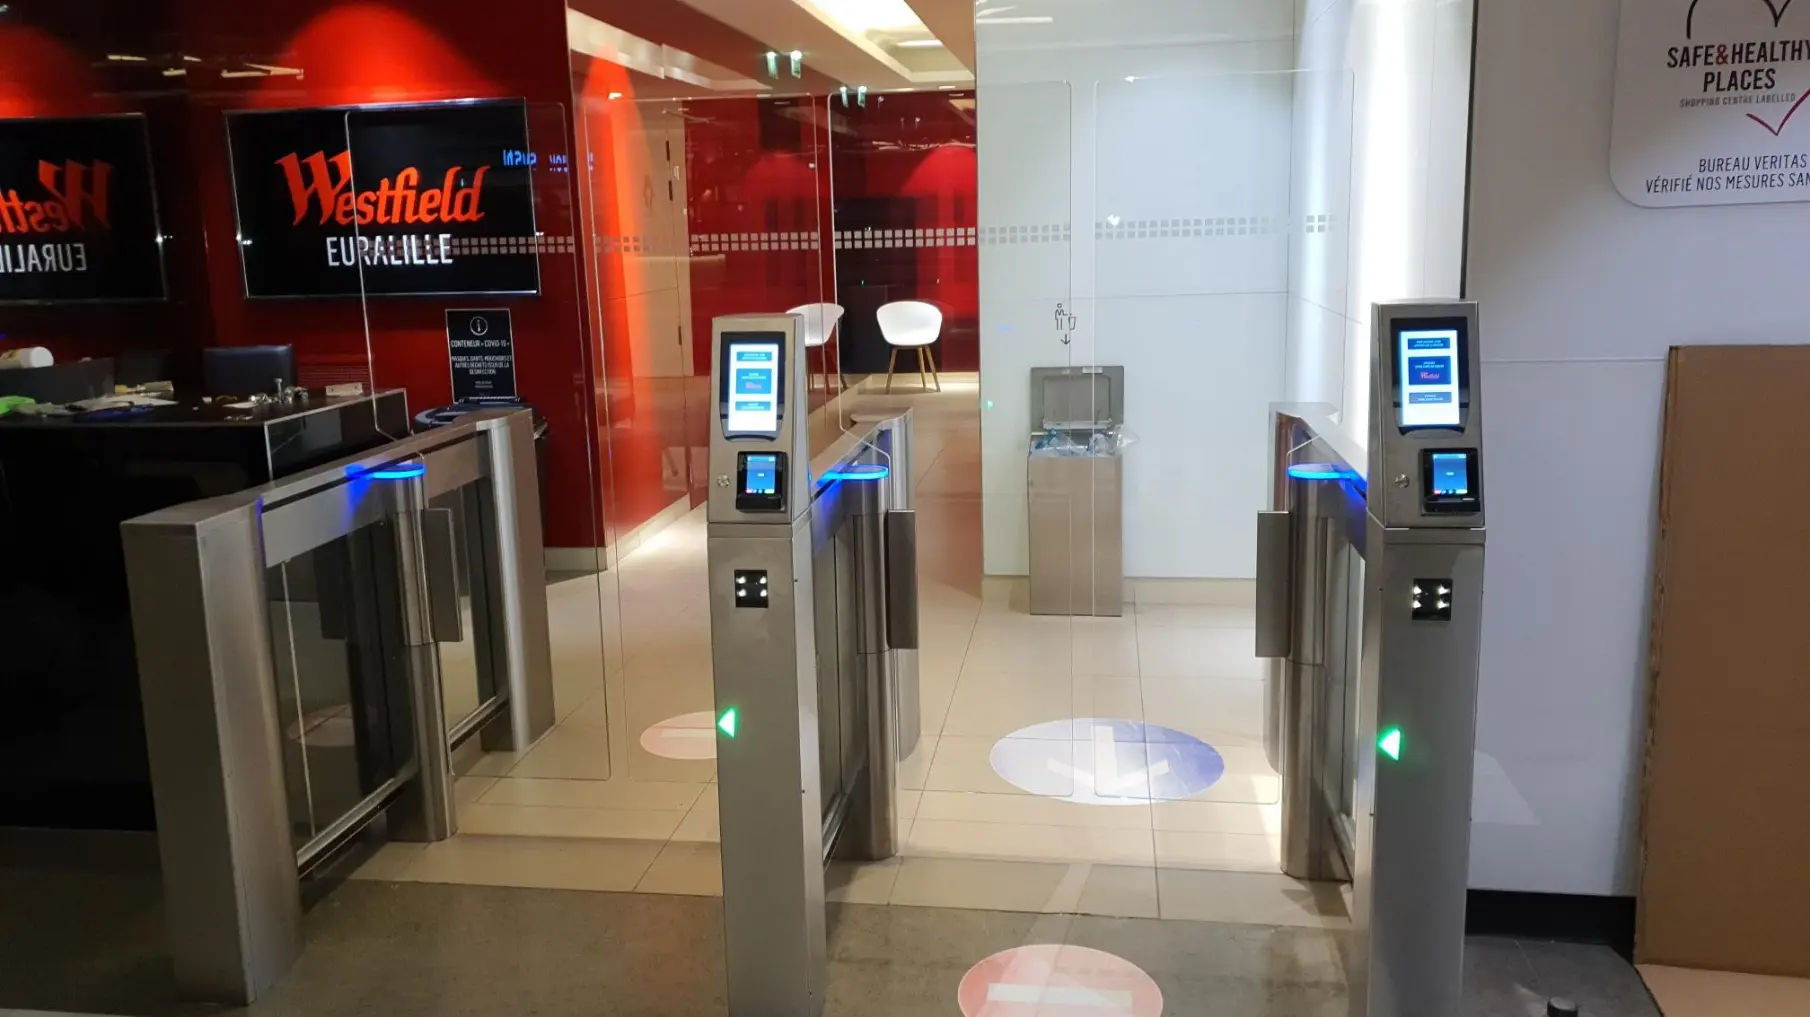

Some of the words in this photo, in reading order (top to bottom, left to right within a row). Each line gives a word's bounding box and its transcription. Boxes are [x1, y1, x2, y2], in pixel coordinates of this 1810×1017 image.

[1702, 68, 1776, 93] PLACES
[1680, 95, 1720, 108] SHOPPING
[1722, 94, 1753, 106] CENTRE
[1755, 92, 1796, 105] LABELLED
[1698, 156, 1750, 173] BUREAU
[1754, 153, 1807, 170] VERITAS
[274, 149, 492, 227] Westfield
[1645, 174, 1692, 193] VÉRIFIÉ
[1696, 176, 1722, 191] NOS
[1725, 173, 1784, 190] MESURES
[326, 232, 454, 267] EURALILLE
